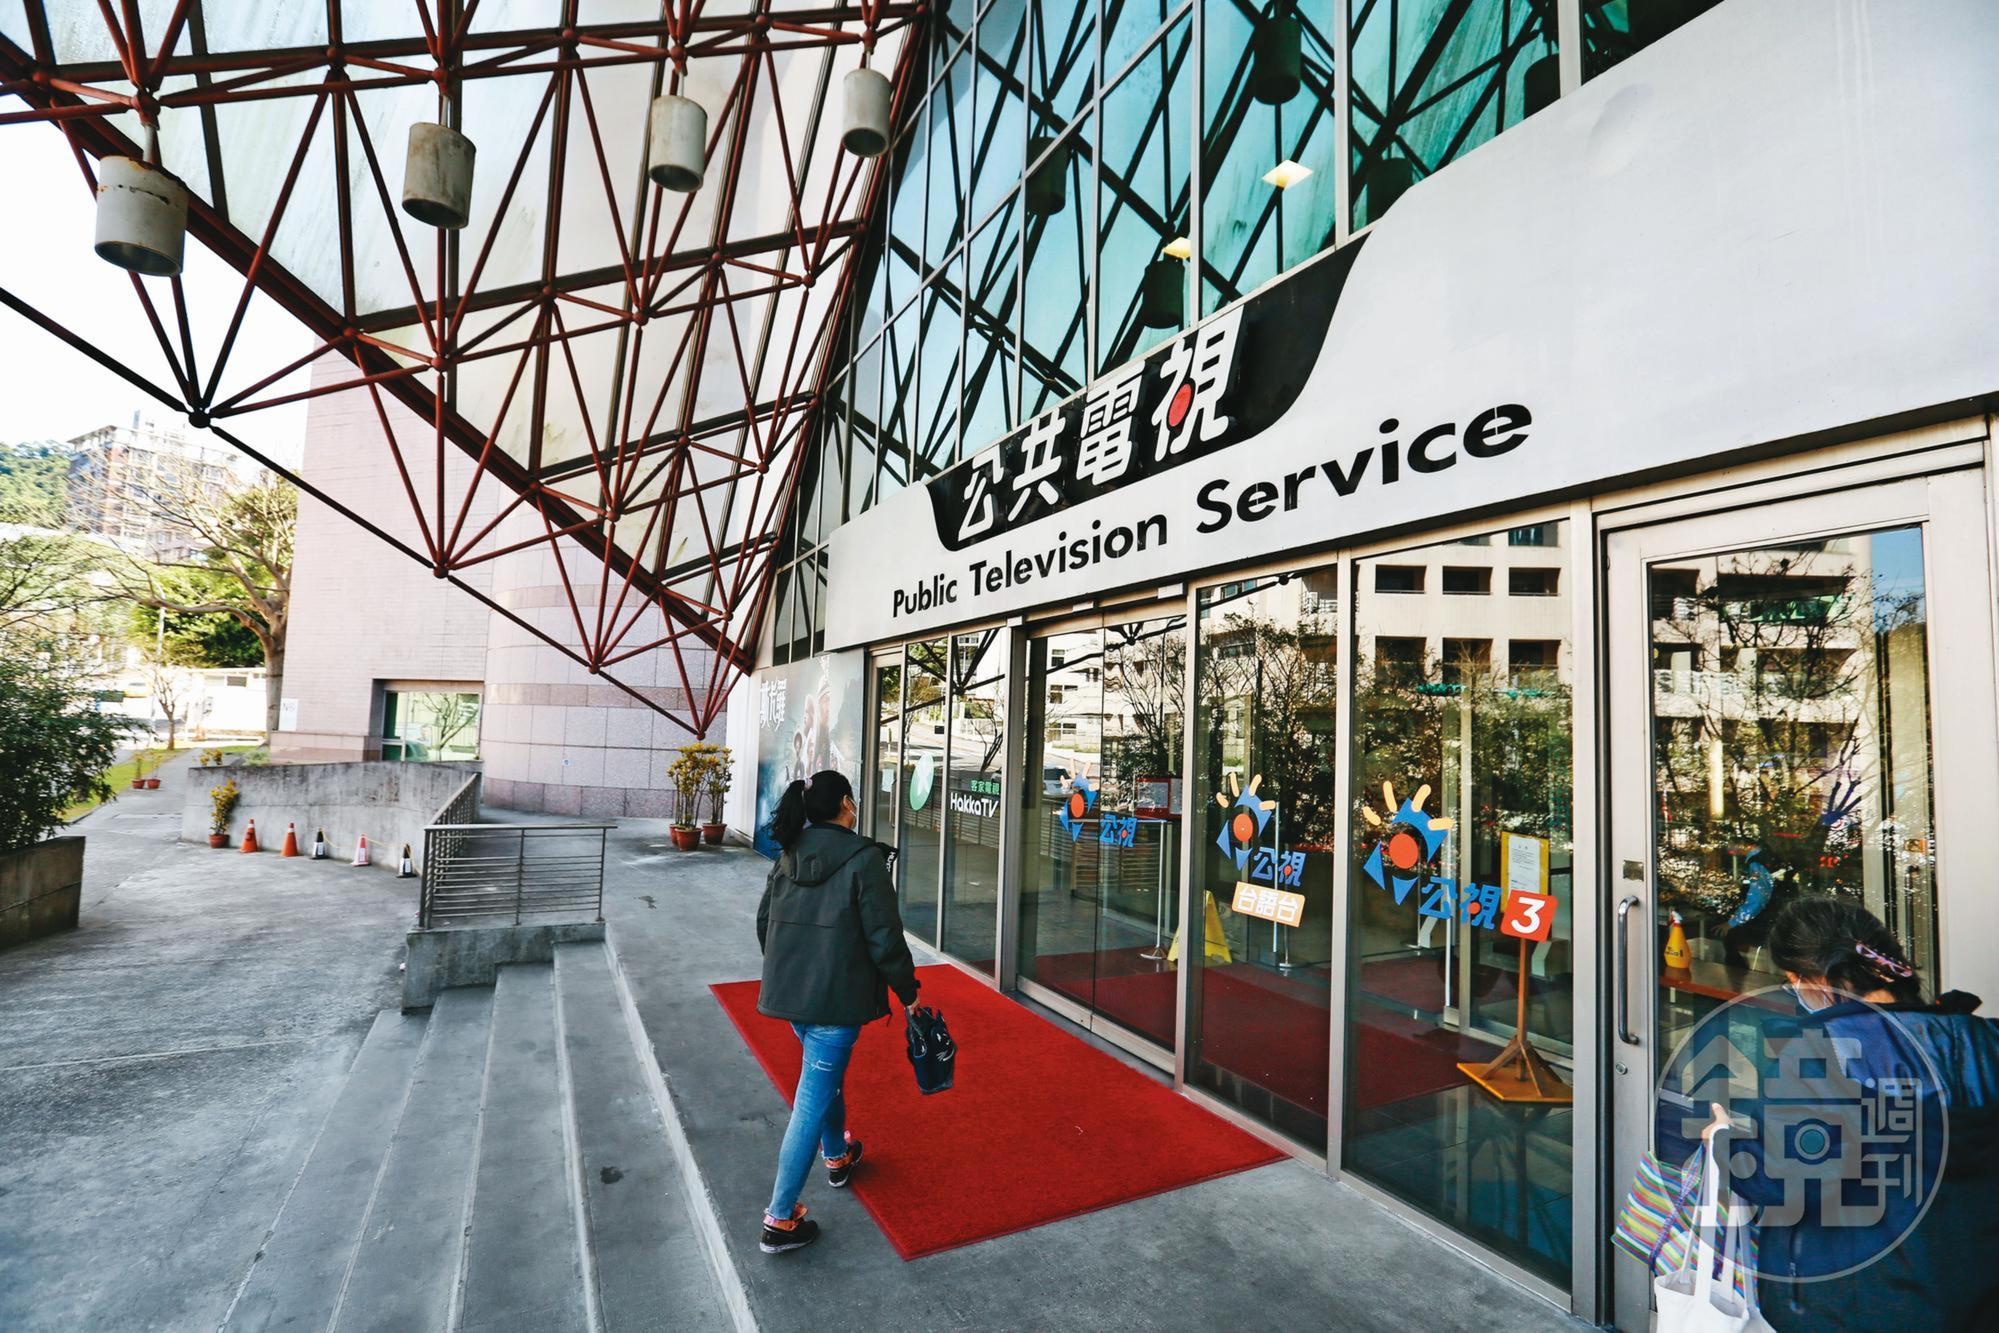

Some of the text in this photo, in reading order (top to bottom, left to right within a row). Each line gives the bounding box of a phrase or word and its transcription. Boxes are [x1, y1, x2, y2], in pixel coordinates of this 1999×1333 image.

[958, 304, 1244, 541] 公共電視
[893, 403, 1532, 617] Public Television Service
[1100, 814, 1137, 848] 公視
[1252, 847, 1306, 887] 公視
[1237, 886, 1299, 922] 台語台
[1418, 876, 1546, 934] 公視 3
